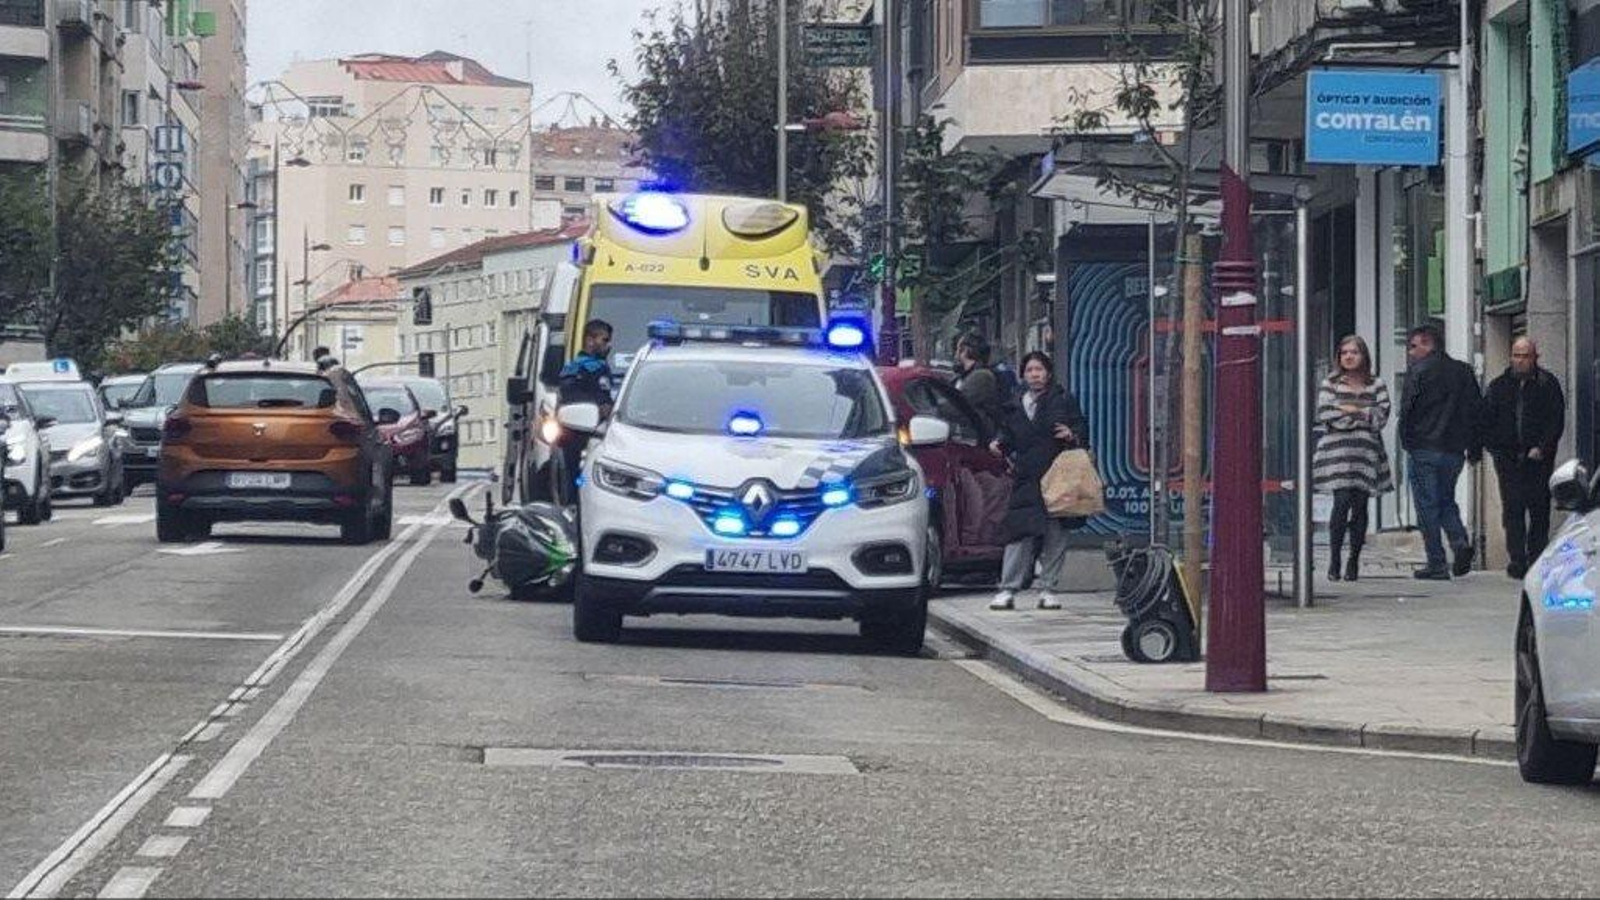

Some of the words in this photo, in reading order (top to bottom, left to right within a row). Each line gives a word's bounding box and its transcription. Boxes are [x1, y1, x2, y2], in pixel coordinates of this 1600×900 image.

[1363, 95, 1371, 104] Y
[745, 264, 800, 281] SVA
[1106, 487, 1138, 499] 0.0%
[1125, 501, 1151, 513] 100
[717, 551, 762, 569] 4747
[768, 553, 802, 570] LVD
